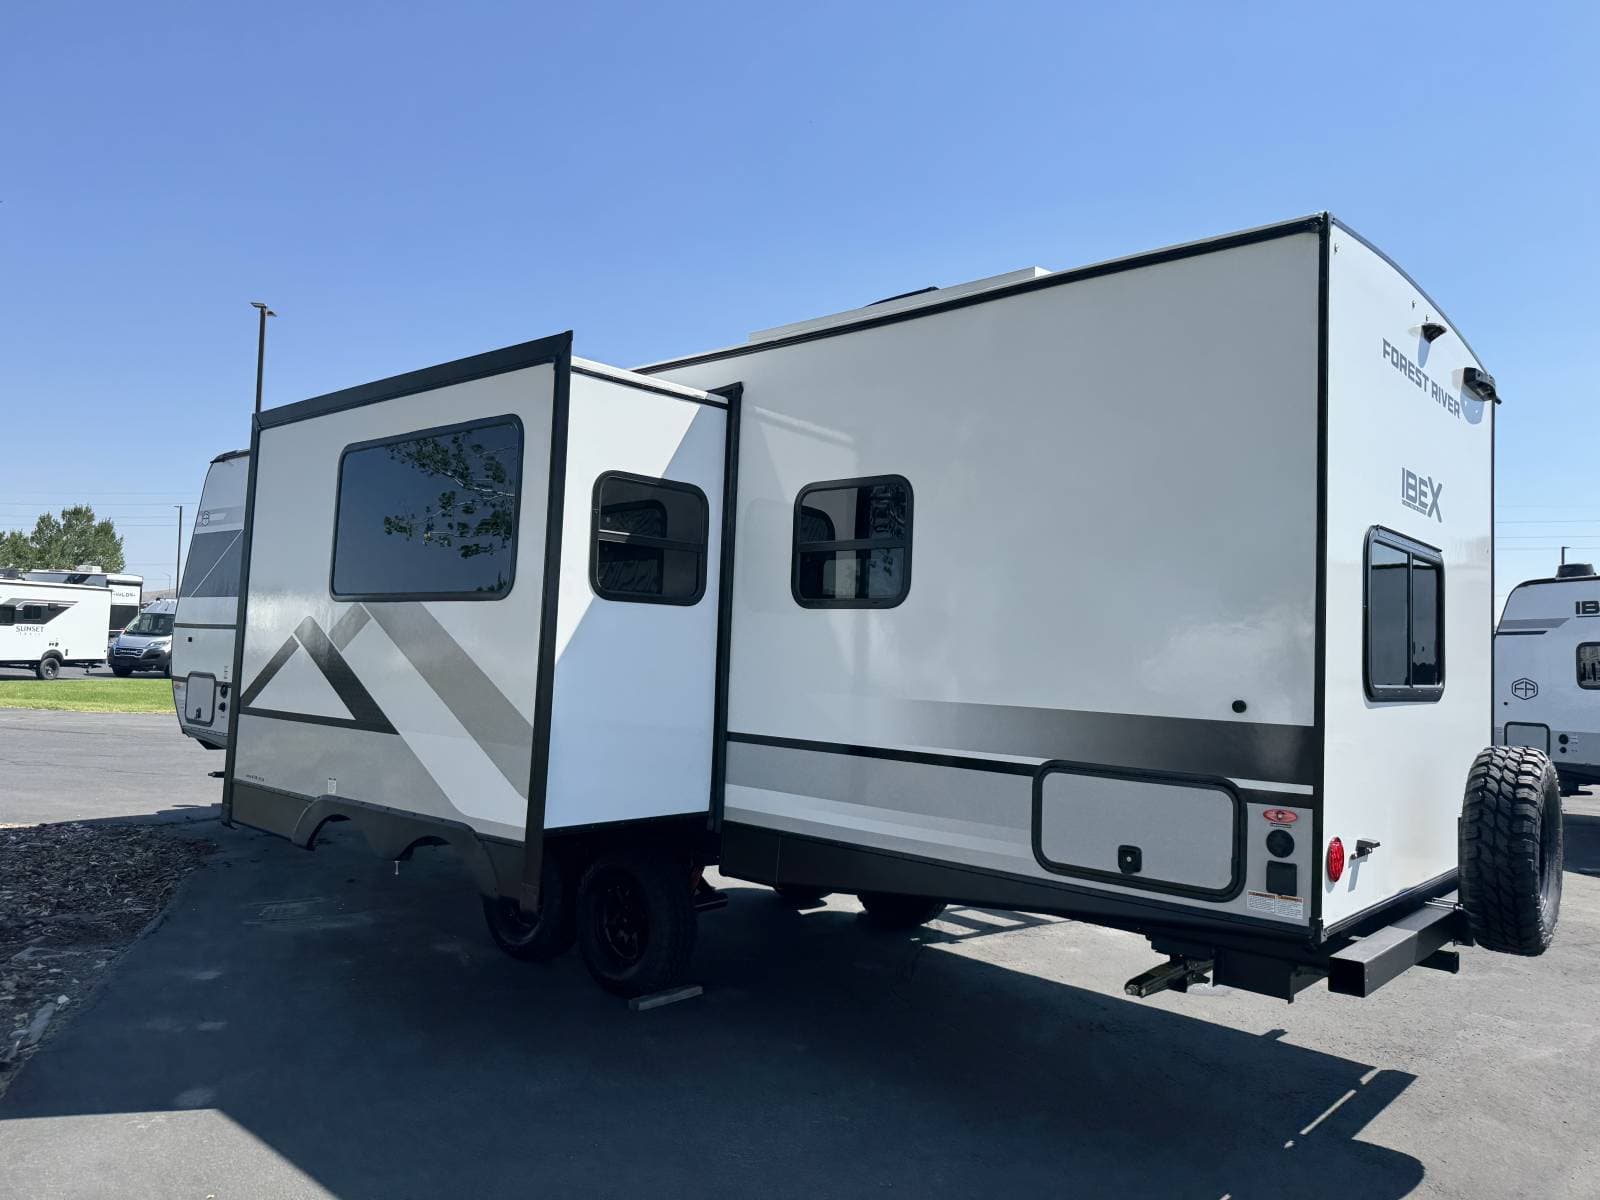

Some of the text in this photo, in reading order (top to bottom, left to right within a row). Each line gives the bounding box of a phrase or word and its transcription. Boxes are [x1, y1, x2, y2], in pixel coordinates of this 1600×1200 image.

[1383, 337, 1460, 419] FOREST RIVER
[1402, 467, 1442, 523] IBEX
